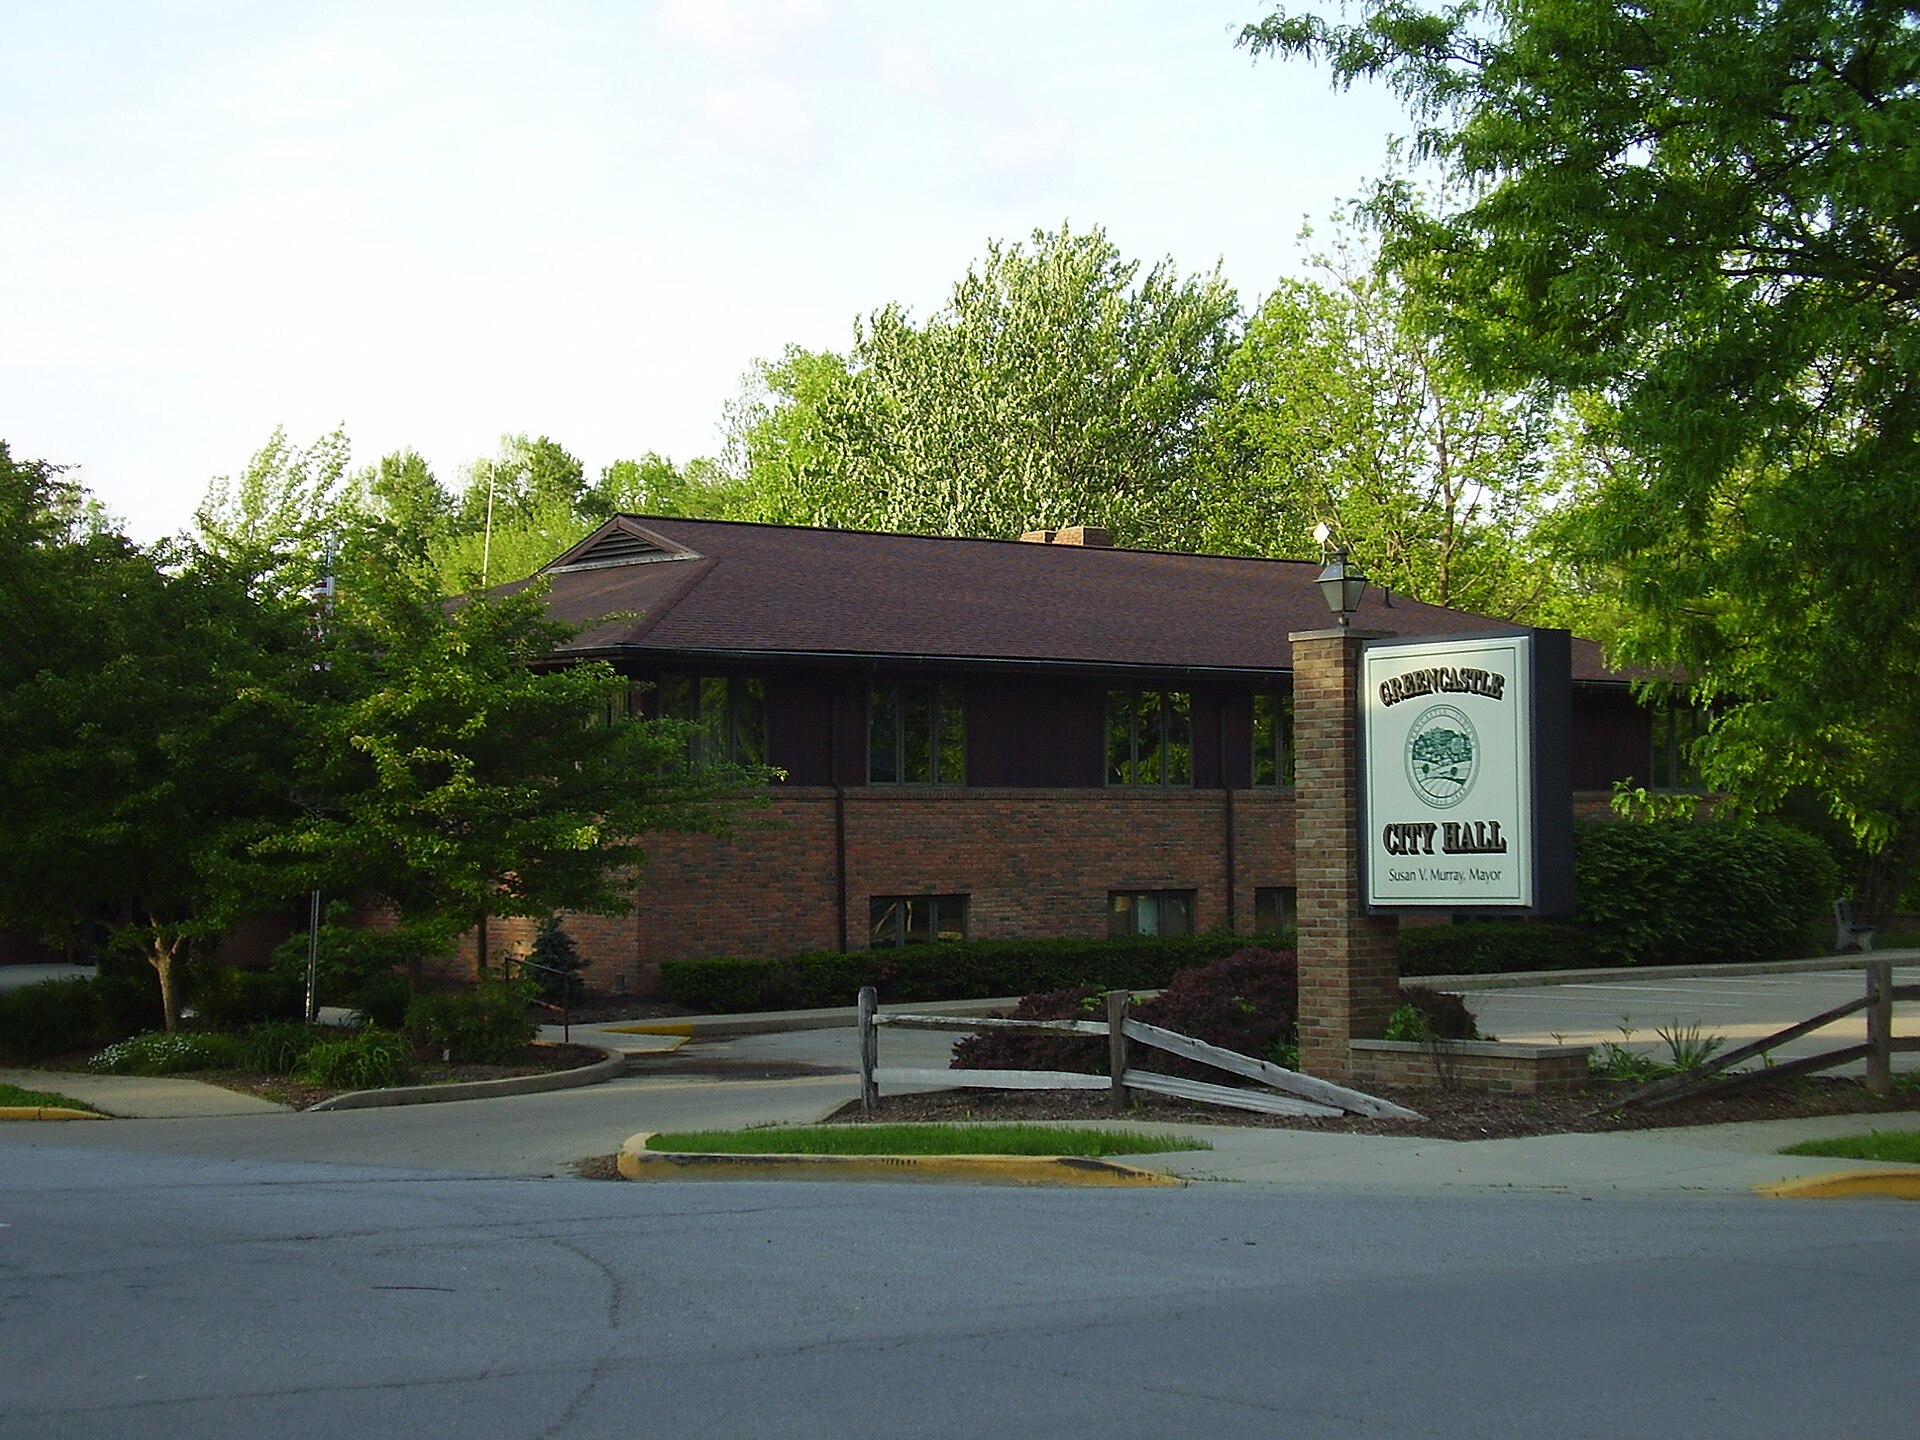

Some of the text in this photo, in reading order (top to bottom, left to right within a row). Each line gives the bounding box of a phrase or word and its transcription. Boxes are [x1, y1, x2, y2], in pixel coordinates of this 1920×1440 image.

[1379, 667, 1505, 707] GREENCASTLE
[1383, 821, 1507, 855] CITY HALL
[1389, 868, 1416, 881] Susan
[1418, 868, 1428, 881] V.
[1469, 868, 1502, 884] Mayor
